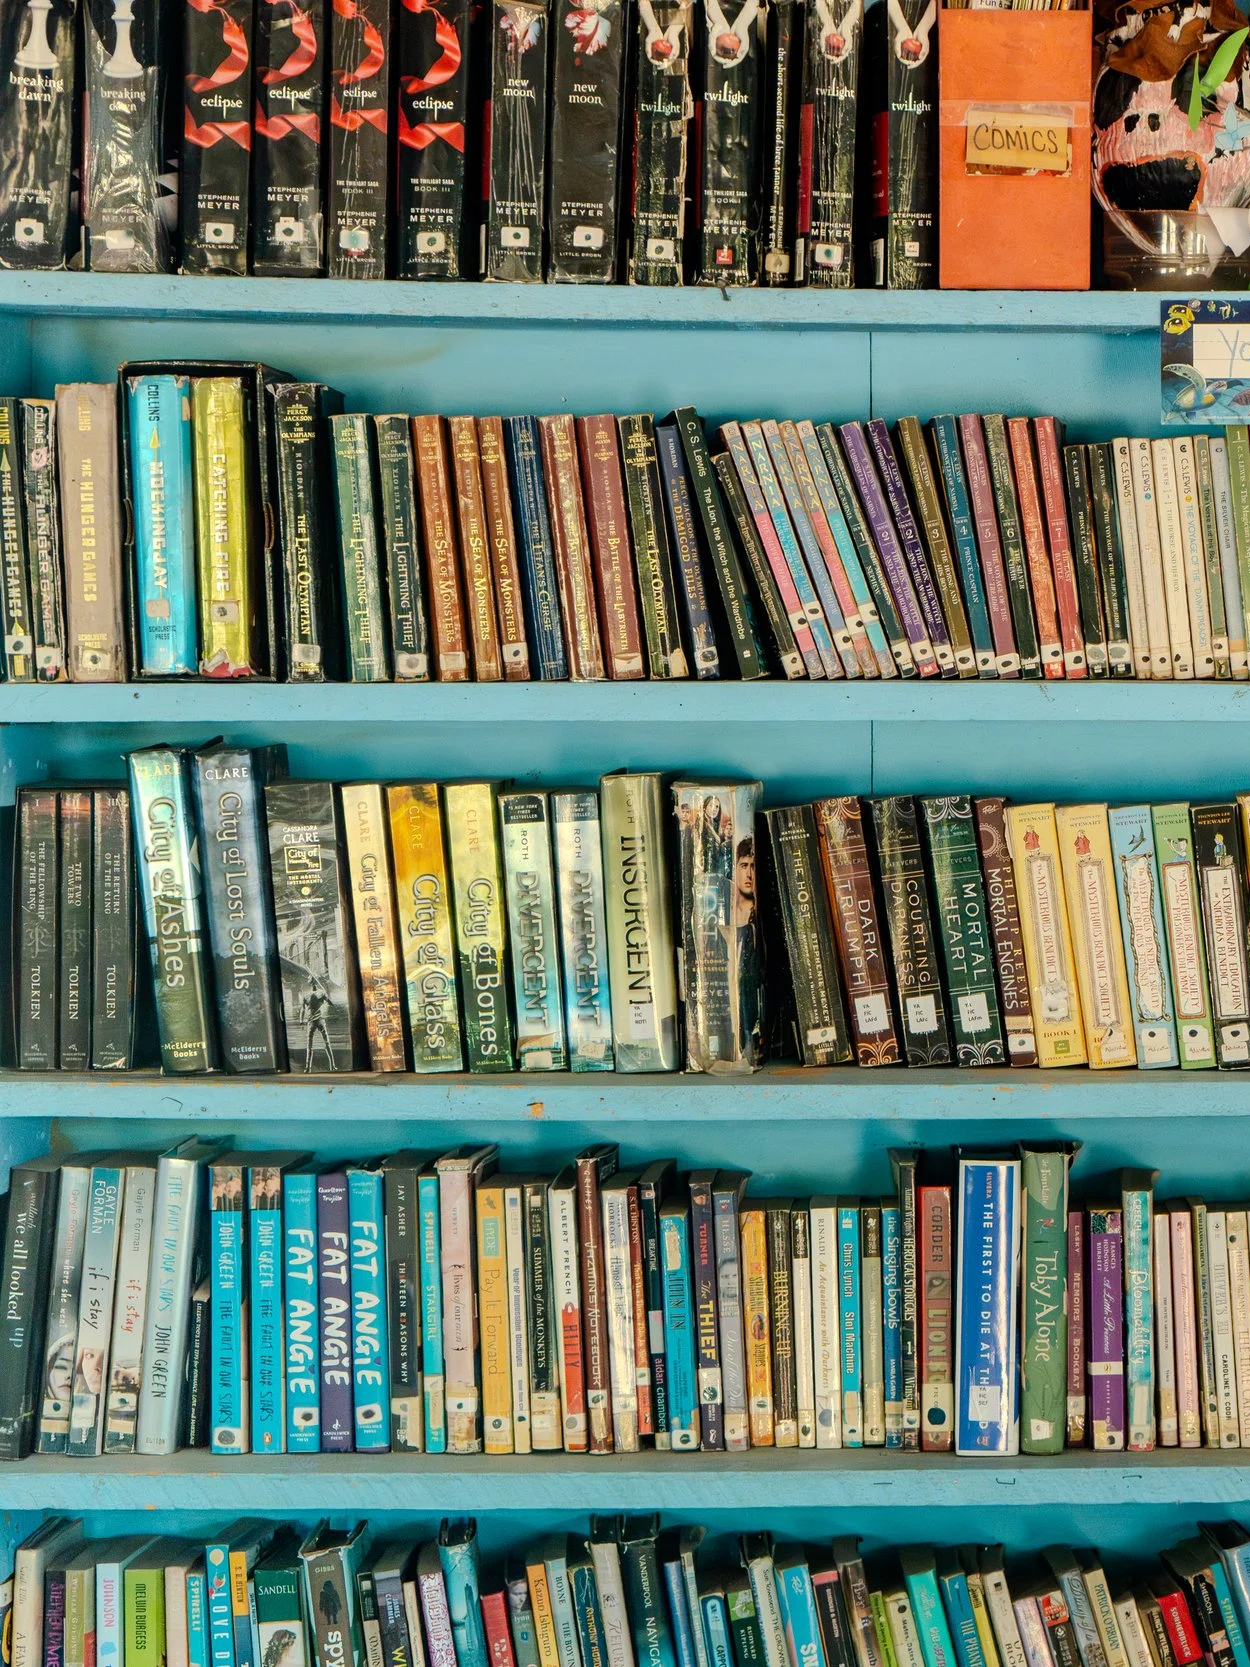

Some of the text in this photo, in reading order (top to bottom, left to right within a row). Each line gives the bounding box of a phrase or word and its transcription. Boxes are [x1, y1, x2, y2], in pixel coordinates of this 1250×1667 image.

[9, 73, 64, 91] breaking
[18, 87, 52, 102] dawn
[100, 87, 145, 103] breaking
[269, 87, 311, 109] eclipse
[343, 88, 377, 108] eclipse
[503, 85, 536, 100] moon
[507, 77, 529, 88] new
[568, 93, 604, 106] moon
[573, 82, 597, 93] new
[641, 93, 680, 115] twilight
[704, 81, 748, 106] twilight
[815, 77, 855, 100] twilight
[891, 85, 931, 114] twilight
[201, 96, 243, 119] eclipse
[412, 96, 454, 120] eclipse
[974, 121, 1058, 154] COMICS
[197, 201, 240, 210] MEYER
[198, 193, 240, 202] STEPHENIE
[561, 201, 603, 209] STEPHENIE
[561, 208, 603, 217] MEYER
[148, 385, 160, 422] COLLINS
[284, 414, 312, 422] JACKSON
[287, 409, 308, 417] PERCY
[80, 458, 97, 602] THE HUNGER GAMES
[148, 461, 167, 590] MOCKINGJAY
[212, 453, 230, 592] CATCHING FIRE
[692, 448, 706, 477] Lewis
[703, 486, 712, 504] The
[712, 526, 720, 541] the
[716, 541, 728, 566] Witch
[723, 566, 731, 583] and
[727, 584, 735, 598] the
[731, 599, 745, 640] Wardrobe
[959, 526, 968, 536] 4
[1006, 527, 1015, 538] 6
[297, 515, 311, 636] THE LAST OLYMPIAN
[434, 520, 455, 643] THE SEA MONSTERS
[205, 768, 248, 780] CLARE
[282, 832, 320, 842] CLARE
[217, 793, 255, 991] City of Lost Souls
[161, 902, 189, 988] Ashes
[620, 834, 653, 1008] INSURGENT
[837, 879, 867, 986] TRIUMPH
[857, 900, 878, 961] DARK
[944, 896, 967, 975] HEART
[962, 883, 988, 981] MORTAL
[408, 874, 449, 1049] City Glass
[516, 871, 548, 1027] DIVERGENT
[30, 965, 41, 1020] TOLKIEN
[69, 965, 79, 1020] TOLKIEN
[107, 965, 116, 1019] TOLKIEN
[1013, 948, 1028, 1009] REEVE
[473, 973, 500, 1057] Bones
[164, 1041, 206, 1050] McElderry
[173, 1049, 198, 1058] Books
[217, 1220, 235, 1289] JOHN GREEN
[288, 1229, 313, 1285] FAT
[322, 1232, 347, 1284] FAT
[425, 1212, 434, 1263] SPINELLI
[564, 1250, 572, 1295] FRENCH
[981, 1237, 993, 1334] FIRST DIE
[1030, 1250, 1059, 1361] Toby Alone
[699, 1303, 717, 1360] THIEF
[103, 1579, 115, 1628] JOHNSON
[259, 1585, 296, 1596] SANDELL
[639, 1554, 650, 1609] VANDERPOOL
[135, 1584, 146, 1650] MELVIN BURGESS
[534, 1579, 552, 1657] Kazuo Ishiguro
[1170, 1607, 1191, 1658] SONNENBLICK
[1222, 1598, 1241, 1648] SPINELLI
